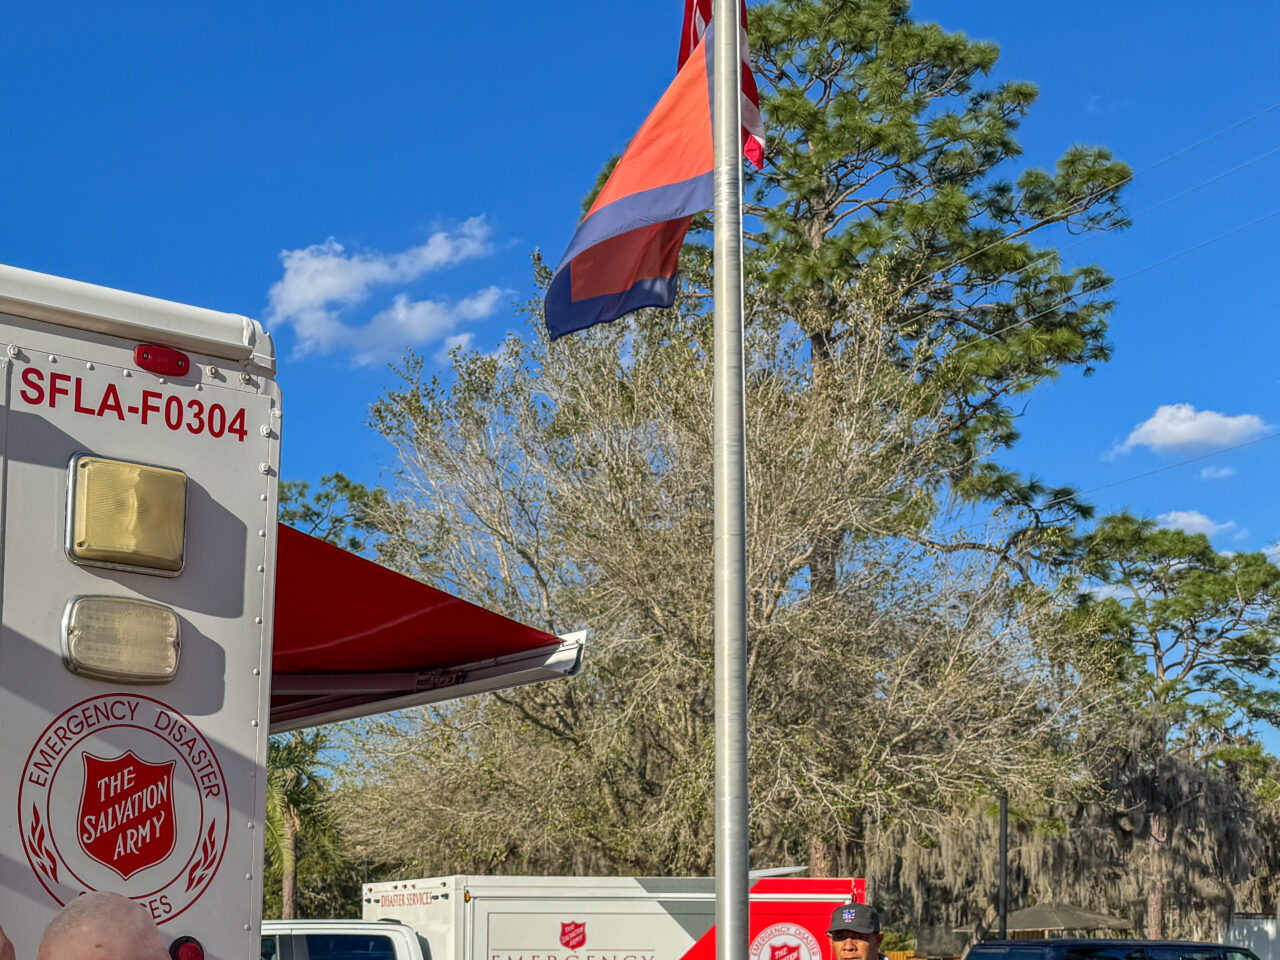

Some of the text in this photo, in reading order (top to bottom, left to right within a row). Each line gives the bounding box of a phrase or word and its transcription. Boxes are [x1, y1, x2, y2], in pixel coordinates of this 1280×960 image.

[20, 367, 248, 442] SFLA-F0304
[29, 700, 221, 799] EMERGENCY DISASTER
[82, 775, 168, 844] SALVATION
[97, 766, 136, 802] THE
[113, 811, 165, 860] ARMY
[381, 892, 432, 907] DISASTER SERVICES
